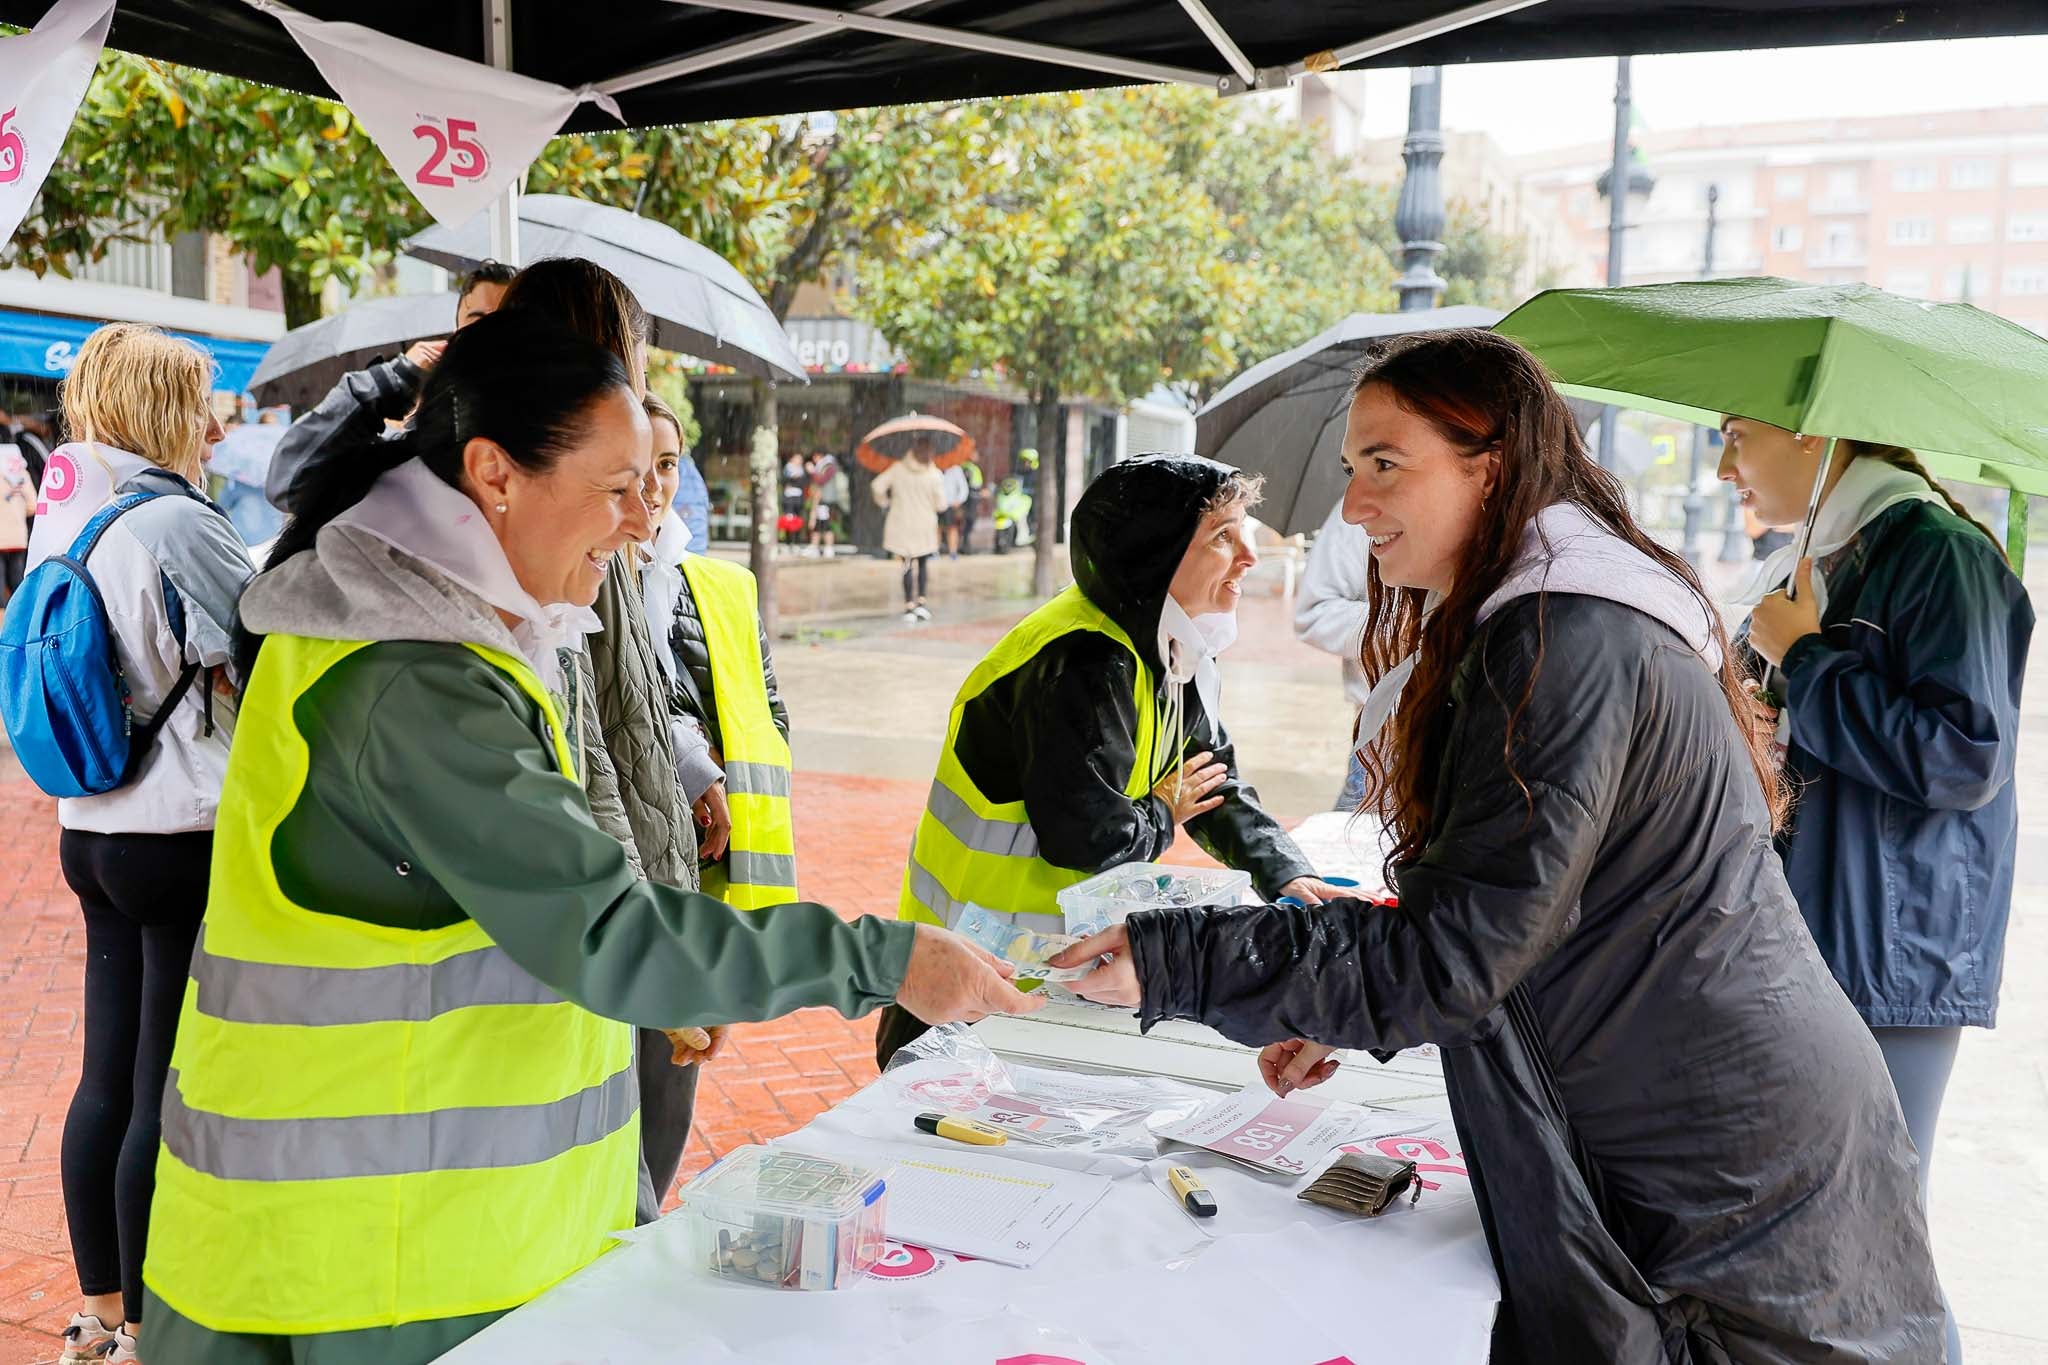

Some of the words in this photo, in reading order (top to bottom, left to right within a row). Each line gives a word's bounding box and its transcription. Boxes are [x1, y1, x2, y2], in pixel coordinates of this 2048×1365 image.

[413, 117, 486, 188] 25
[1018, 968, 1051, 978] 20
[991, 1112, 1032, 1124] 25
[1233, 1121, 1296, 1150] 158
